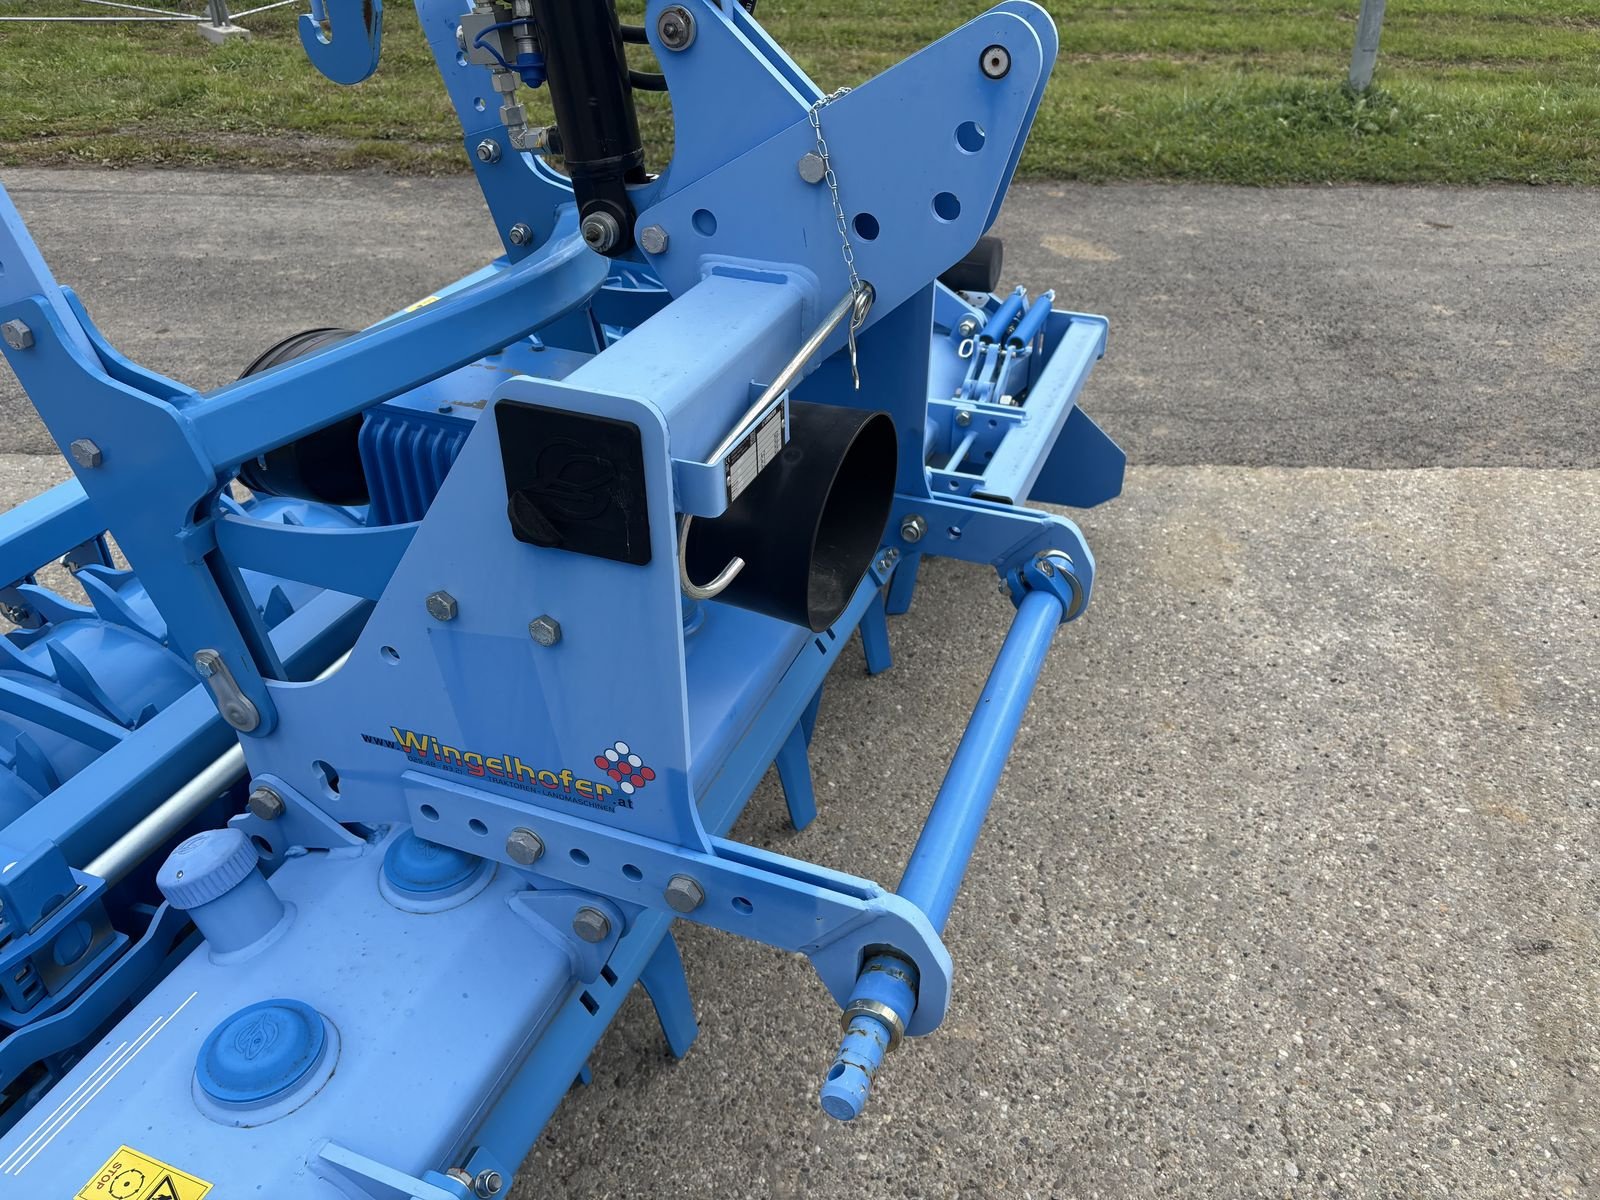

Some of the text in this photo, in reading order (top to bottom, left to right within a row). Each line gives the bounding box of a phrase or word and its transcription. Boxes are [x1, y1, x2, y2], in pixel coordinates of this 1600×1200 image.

[488, 776, 537, 794] TRAKTOREN
[542, 790, 616, 814] LANDMASCHINEN
[96, 1161, 123, 1190] STOP
